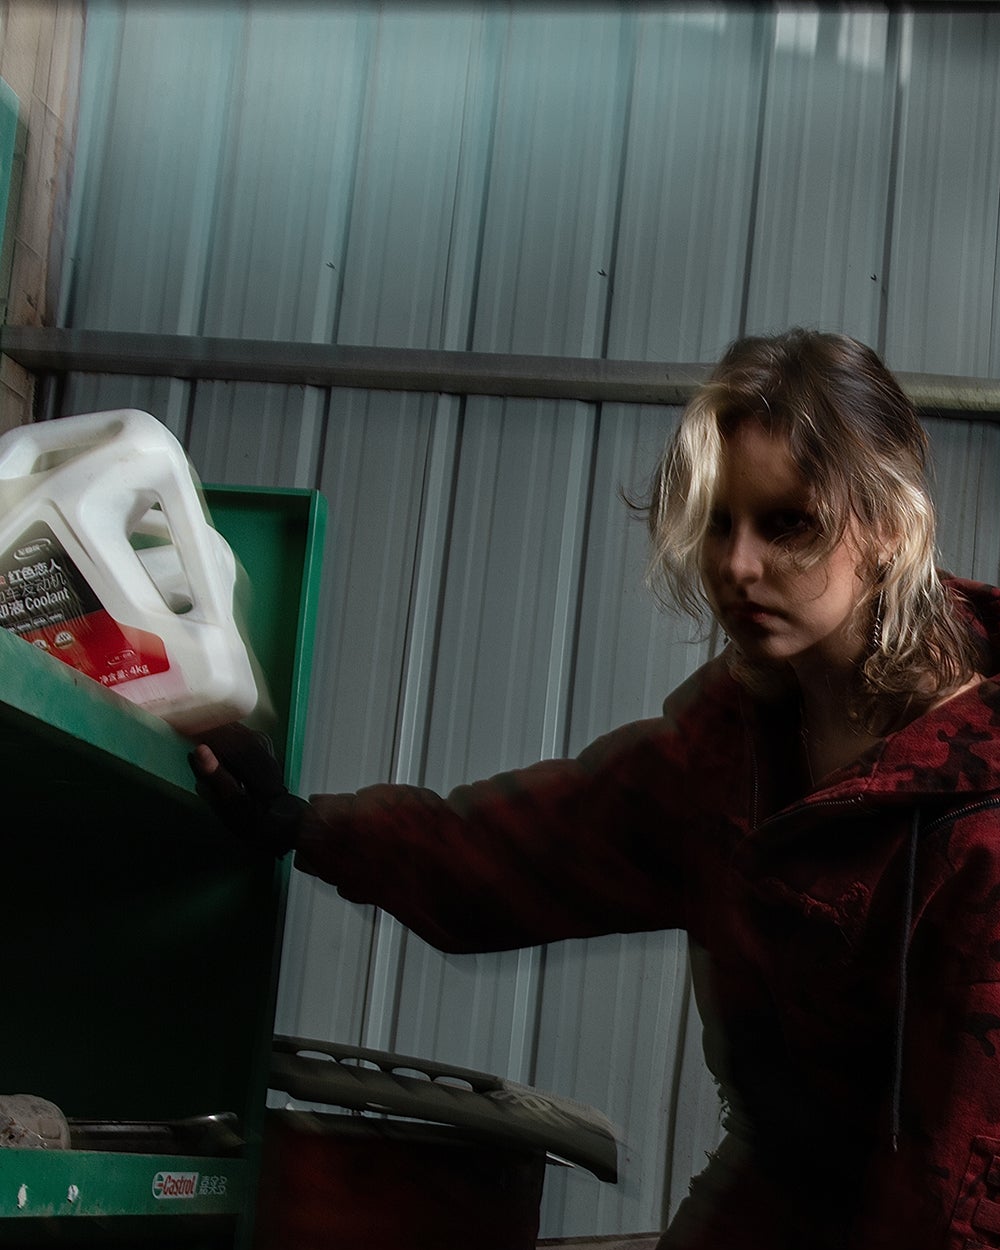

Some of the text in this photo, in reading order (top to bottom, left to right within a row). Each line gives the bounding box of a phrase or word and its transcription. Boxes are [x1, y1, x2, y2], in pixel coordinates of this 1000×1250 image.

[8, 558, 62, 585] 红色恋人
[24, 586, 70, 612] Coolant
[163, 1175, 196, 1195] Castrol
